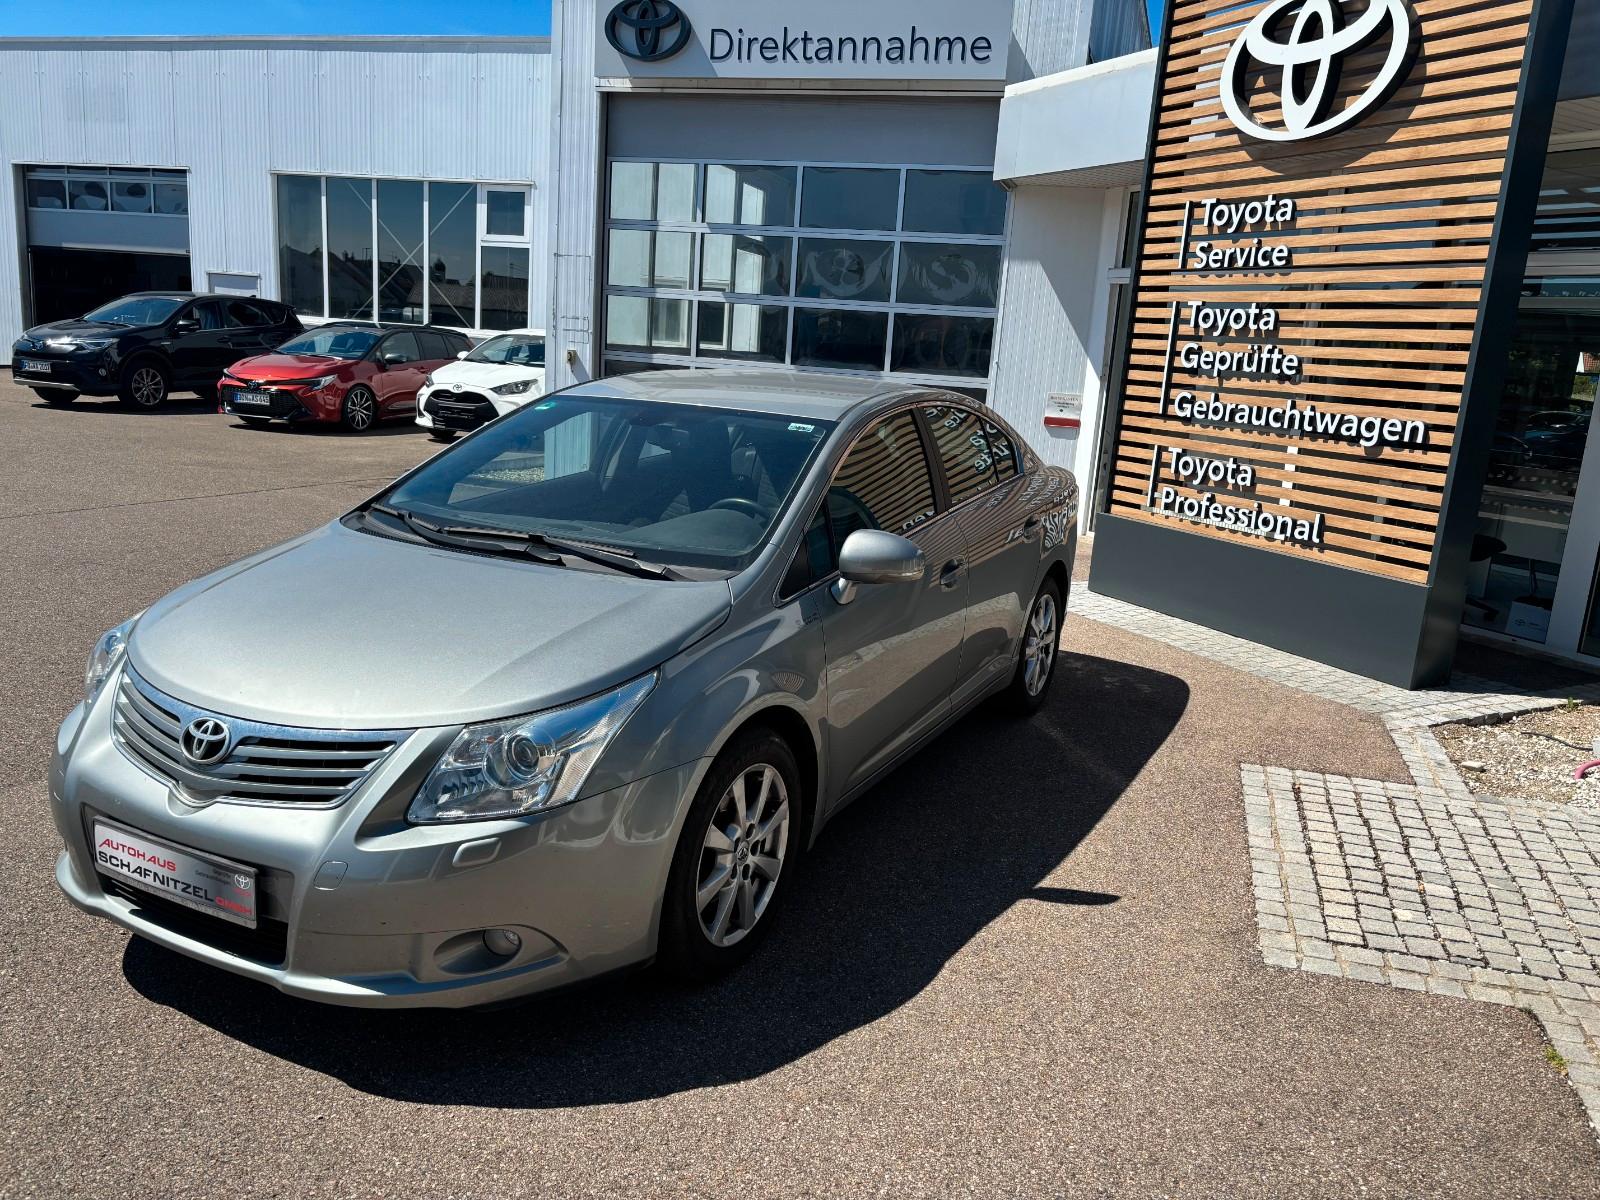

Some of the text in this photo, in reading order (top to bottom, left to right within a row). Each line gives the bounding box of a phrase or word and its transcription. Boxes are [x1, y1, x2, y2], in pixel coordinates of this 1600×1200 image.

[710, 26, 992, 62] Direktannahme
[1201, 194, 1293, 233] Toyota
[1194, 238, 1288, 268] Service
[1188, 301, 1275, 336] Toyota
[1180, 342, 1298, 376] Geprüfte
[1174, 392, 1425, 446] Gebrauchtwagen
[1168, 447, 1252, 487] Toyota
[1160, 486, 1320, 543] Professional
[98, 838, 177, 872] AUTOHAUS
[98, 851, 214, 902] SCHAFNITZEL
